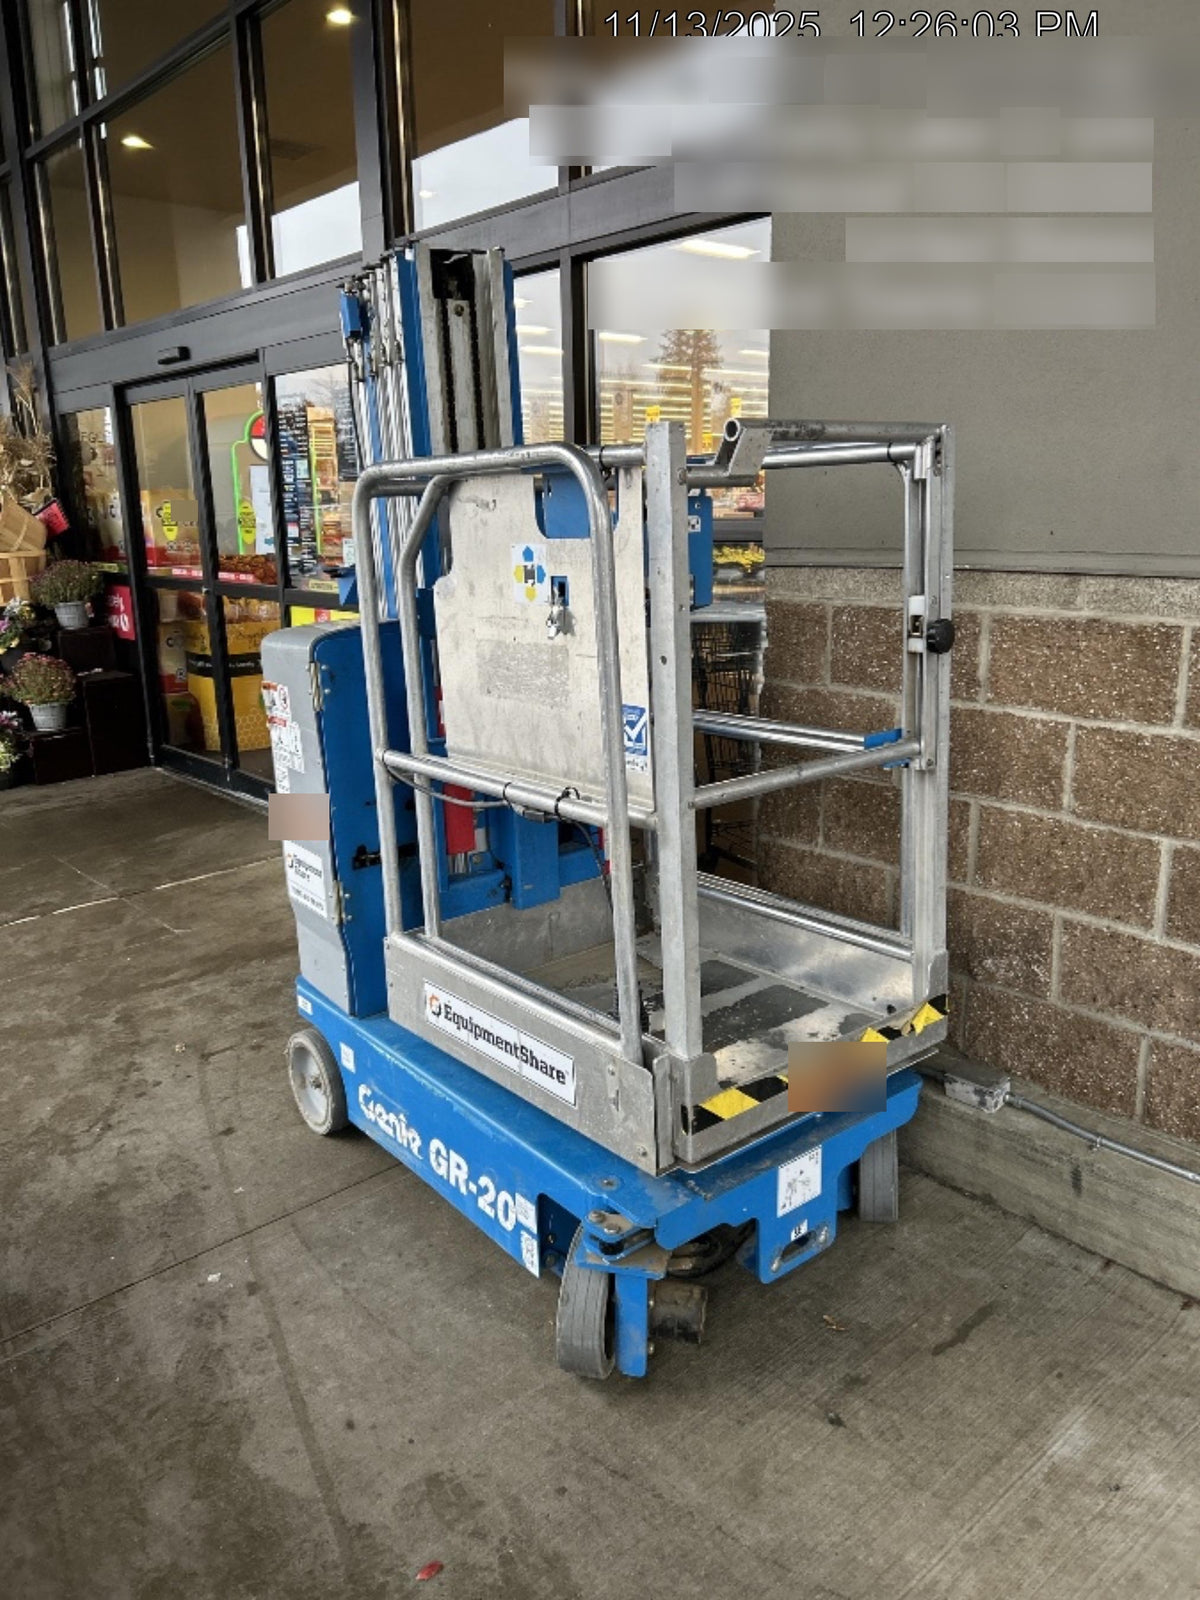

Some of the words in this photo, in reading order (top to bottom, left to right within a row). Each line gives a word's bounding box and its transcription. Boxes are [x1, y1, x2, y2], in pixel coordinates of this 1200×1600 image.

[443, 1001, 567, 1085] EquipmentShare
[357, 1083, 424, 1160] Genie
[429, 1137, 517, 1232] GR-20
